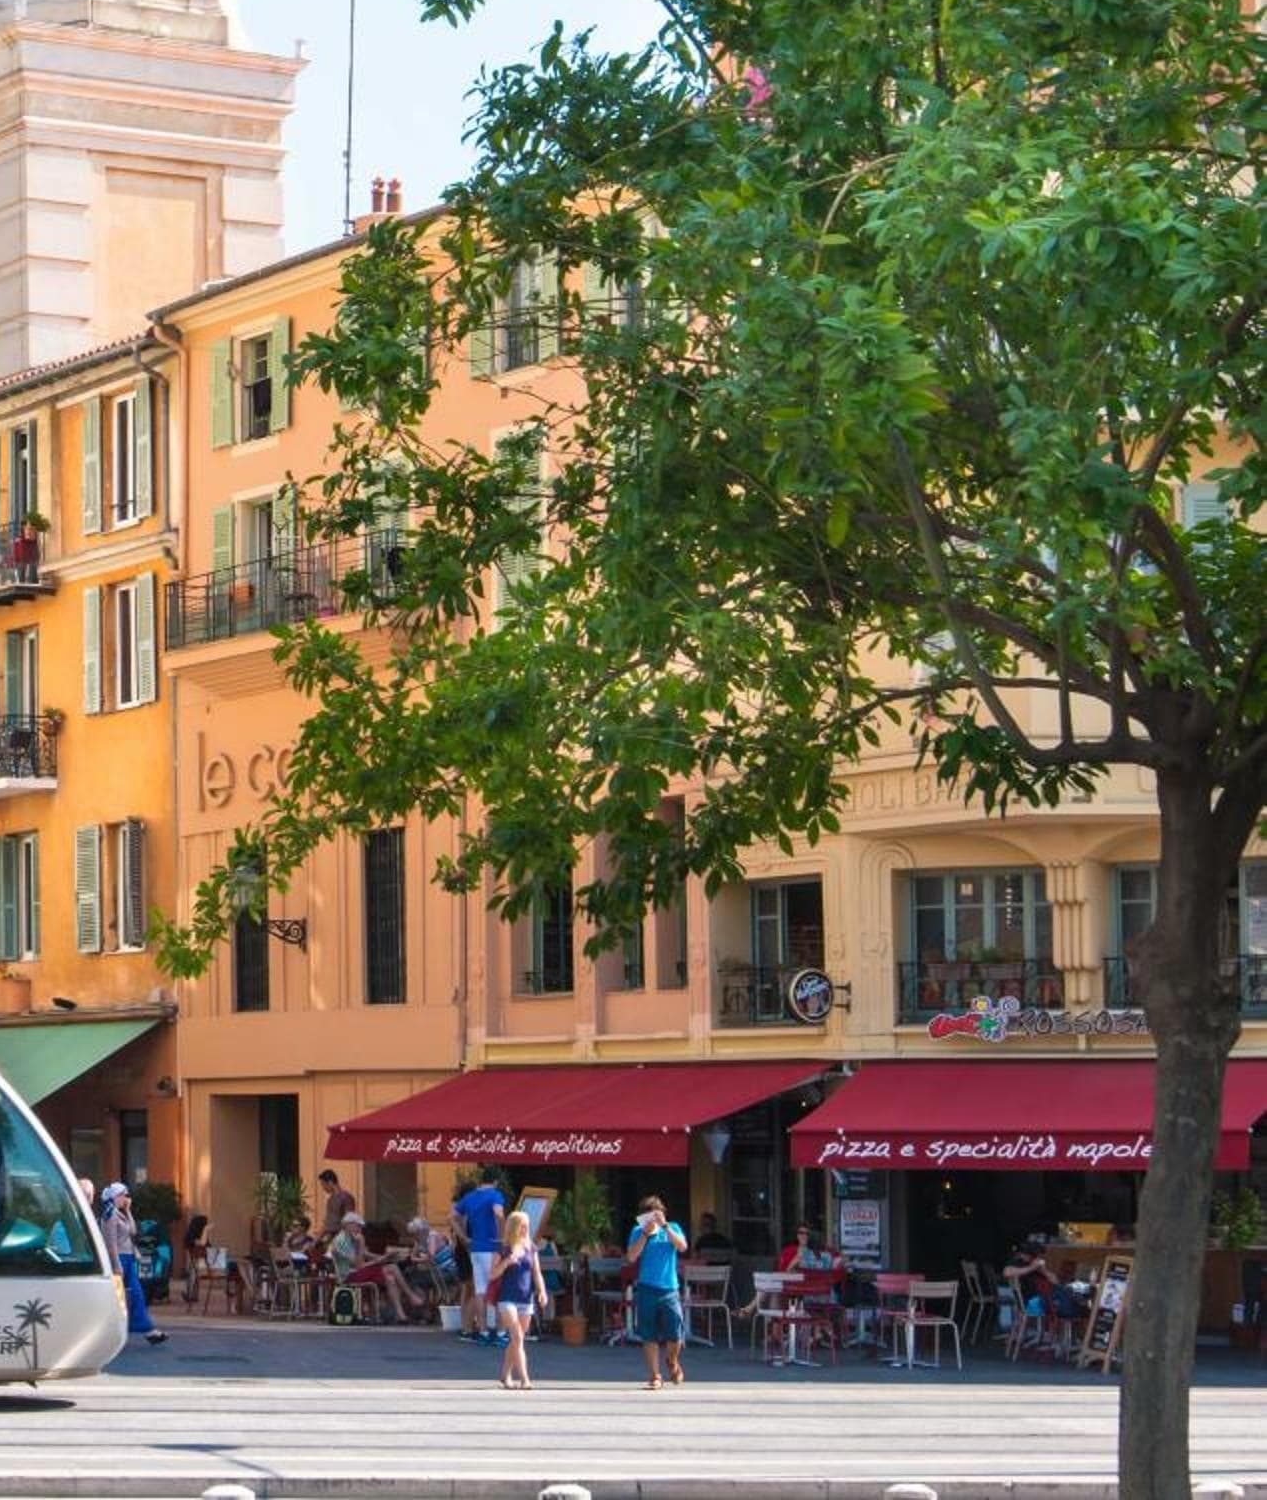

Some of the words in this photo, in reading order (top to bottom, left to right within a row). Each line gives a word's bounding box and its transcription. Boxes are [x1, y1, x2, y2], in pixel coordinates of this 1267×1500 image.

[197, 731, 236, 812] le
[384, 1134, 423, 1156] pizza
[427, 1134, 442, 1152] et
[818, 1137, 891, 1163] pizza
[900, 1143, 915, 1158] e
[925, 1135, 1056, 1166] specialità
